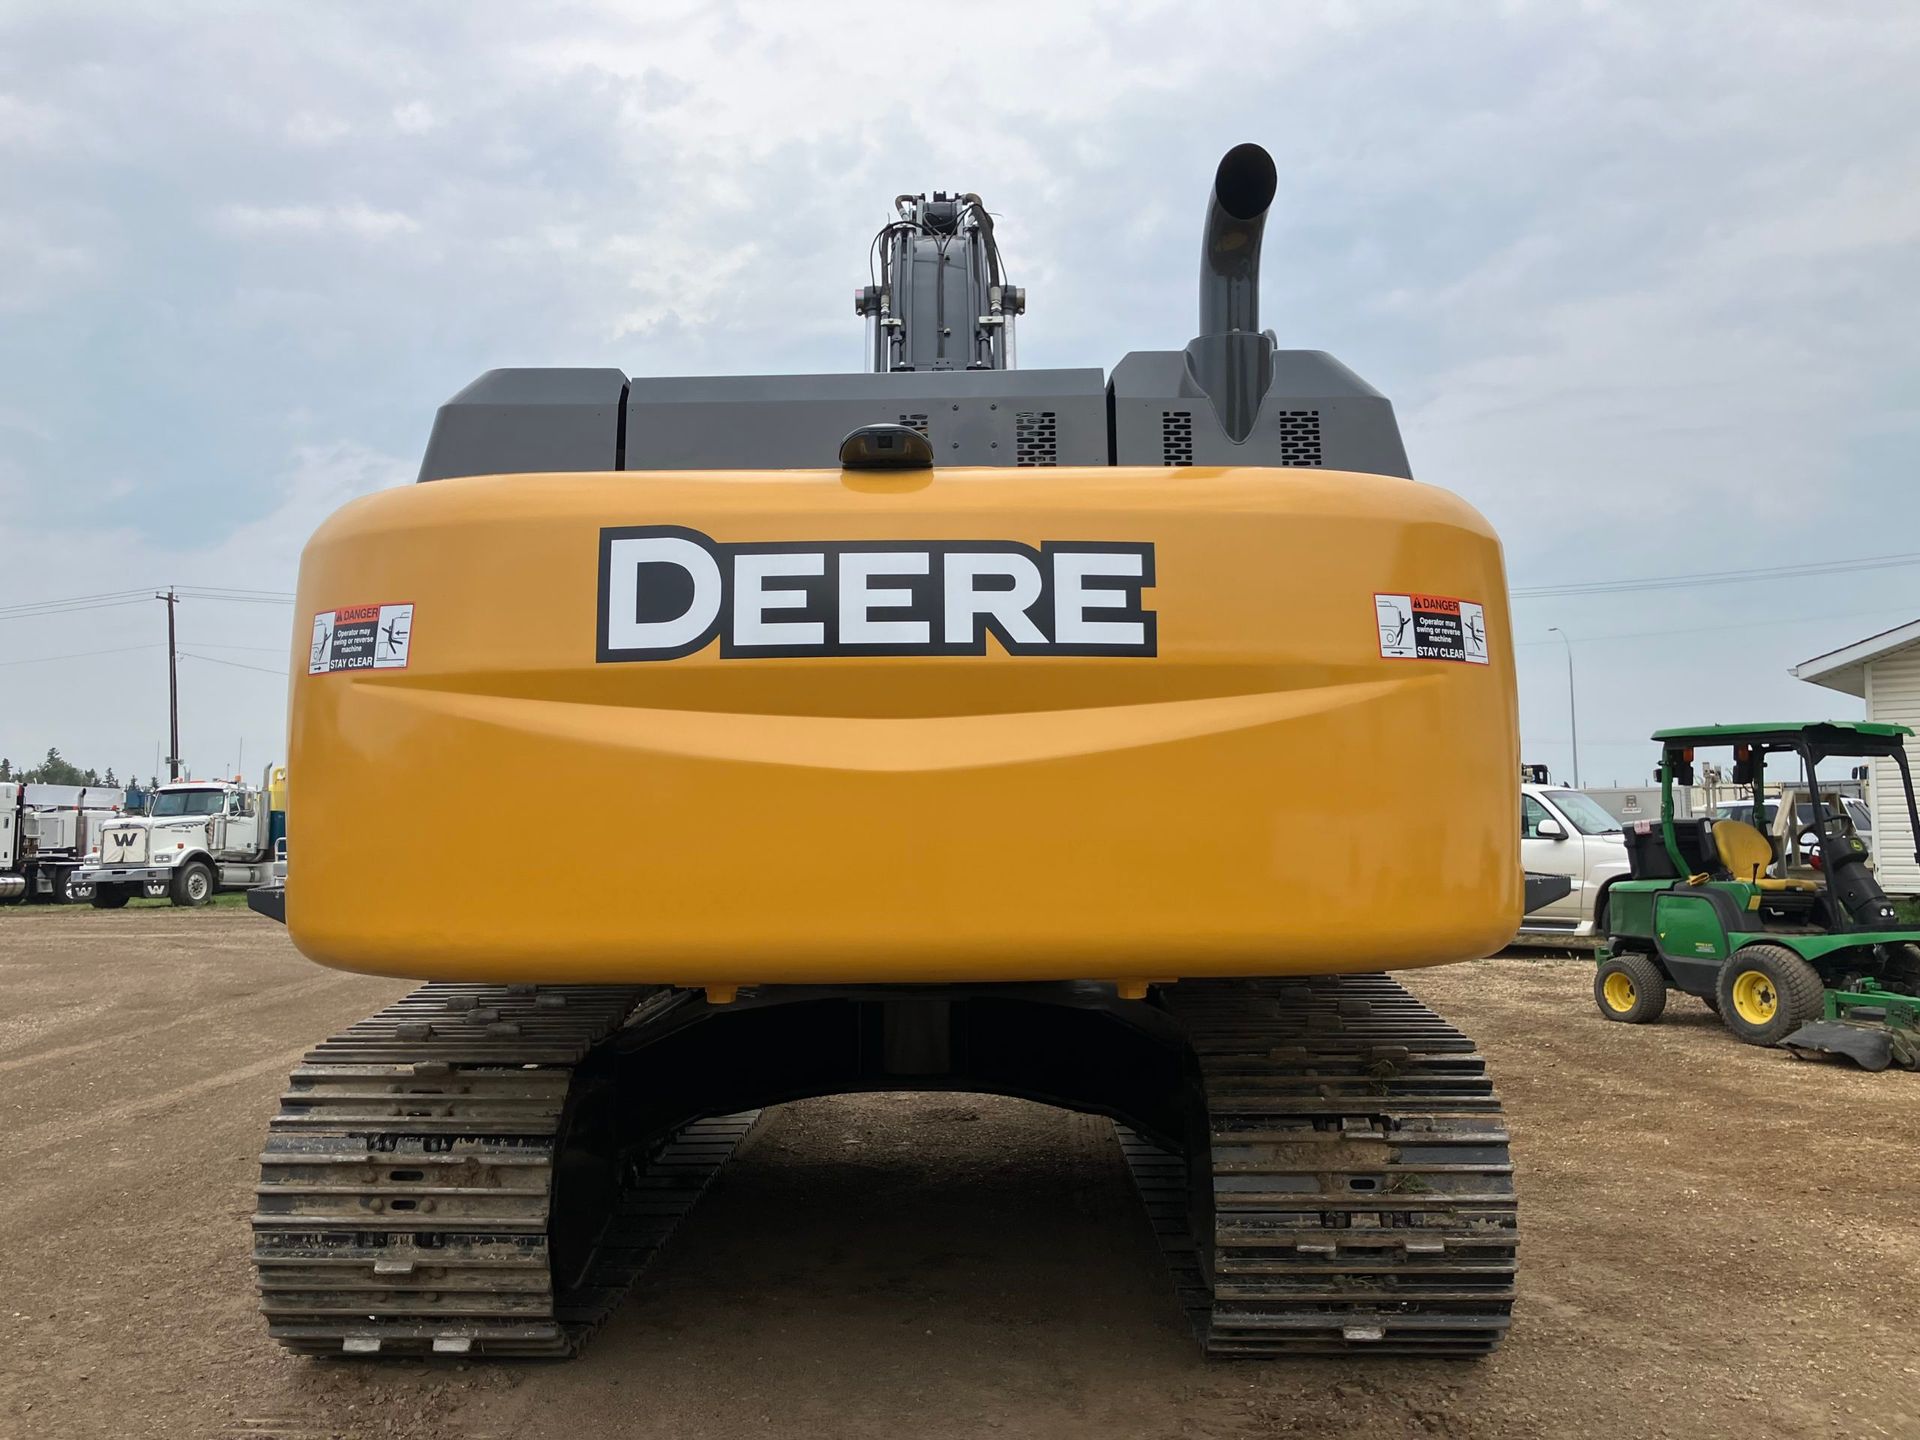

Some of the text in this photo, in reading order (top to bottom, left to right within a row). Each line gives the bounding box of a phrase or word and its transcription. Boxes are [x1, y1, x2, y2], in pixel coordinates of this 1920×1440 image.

[607, 537, 1145, 650] DEERE
[1423, 598, 1459, 611] DANGER
[344, 608, 378, 620] DANGER
[1419, 617, 1456, 628] Operator may
[337, 630, 358, 639] Operator
[1416, 626, 1434, 634] swing
[1441, 628, 1460, 636] reverse
[354, 636, 374, 644] reverse
[341, 645, 362, 653] machine
[1417, 646, 1465, 659] STAY CLEAR
[330, 656, 373, 669] STAY CLEAR
[113, 833, 137, 847] W
